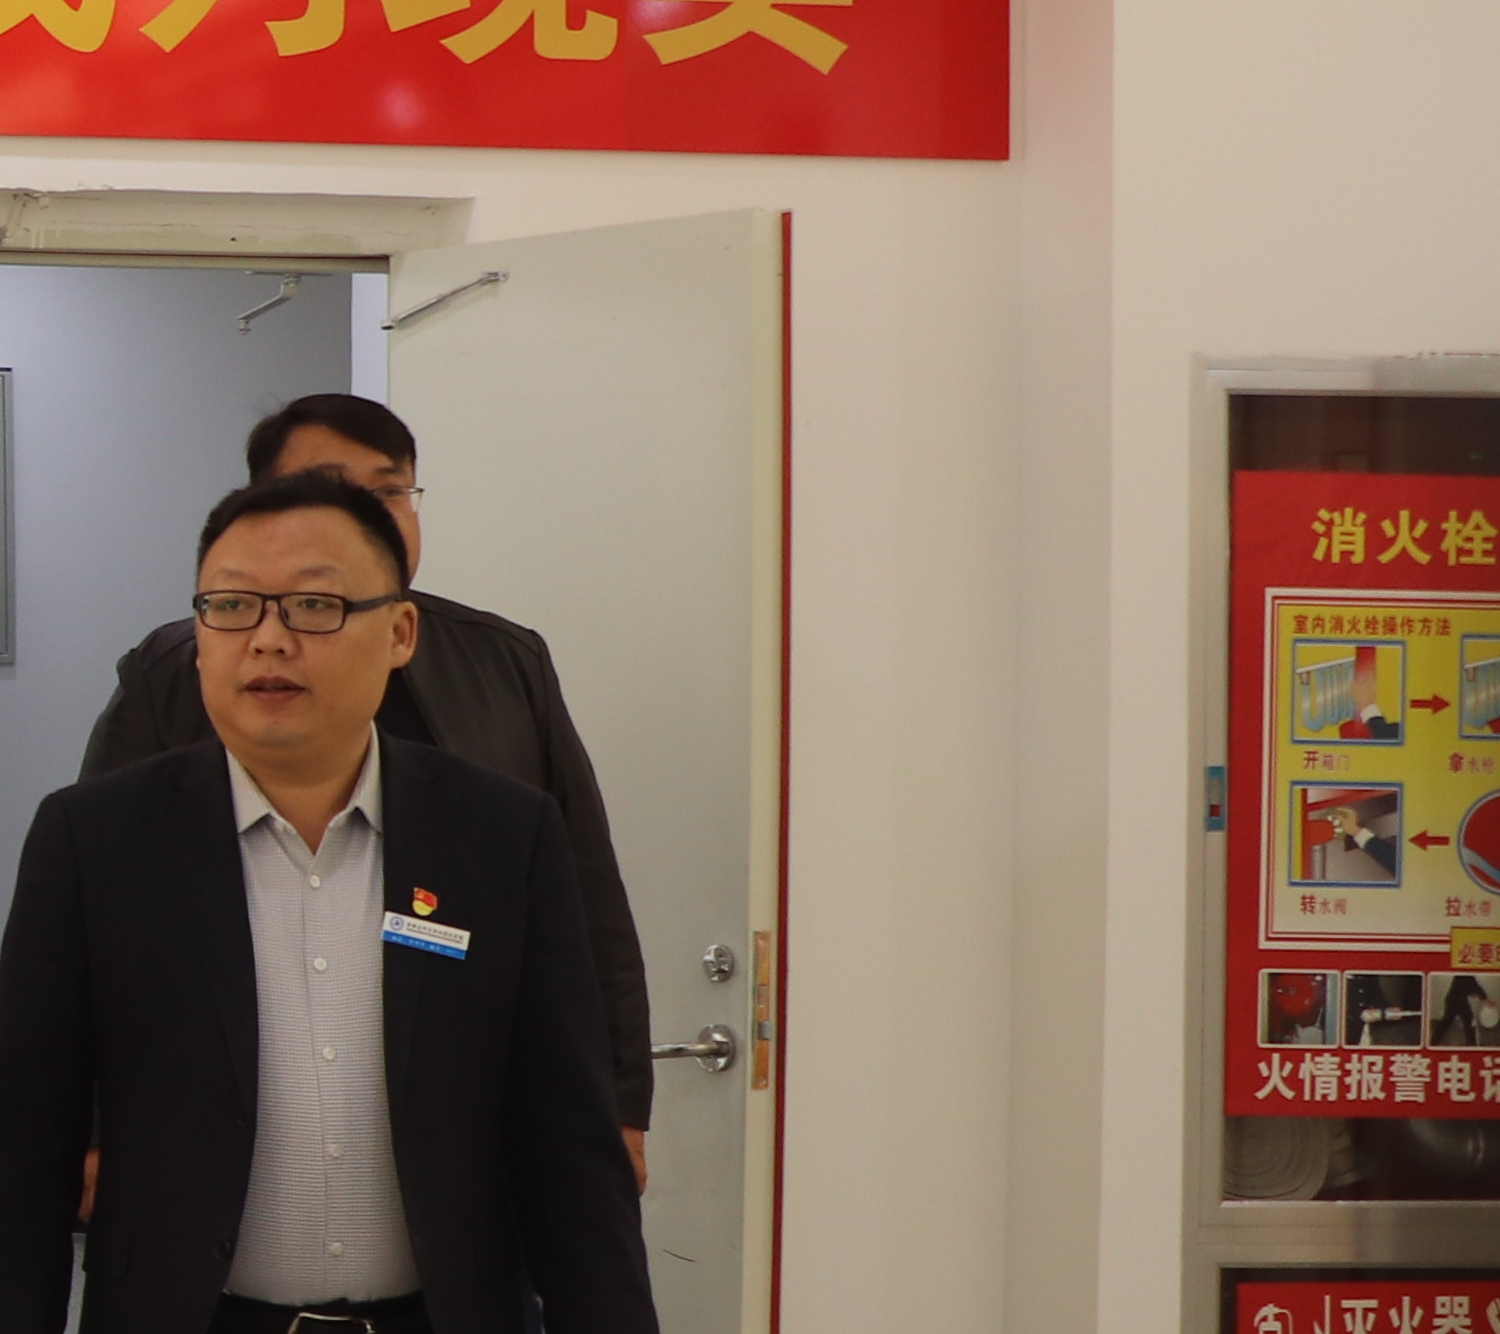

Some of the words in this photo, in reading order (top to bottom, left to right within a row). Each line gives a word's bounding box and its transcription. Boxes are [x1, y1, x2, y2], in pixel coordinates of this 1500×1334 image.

[1311, 507, 1498, 566] 消火栓
[1292, 614, 1451, 636] 室内消火栓操作方法
